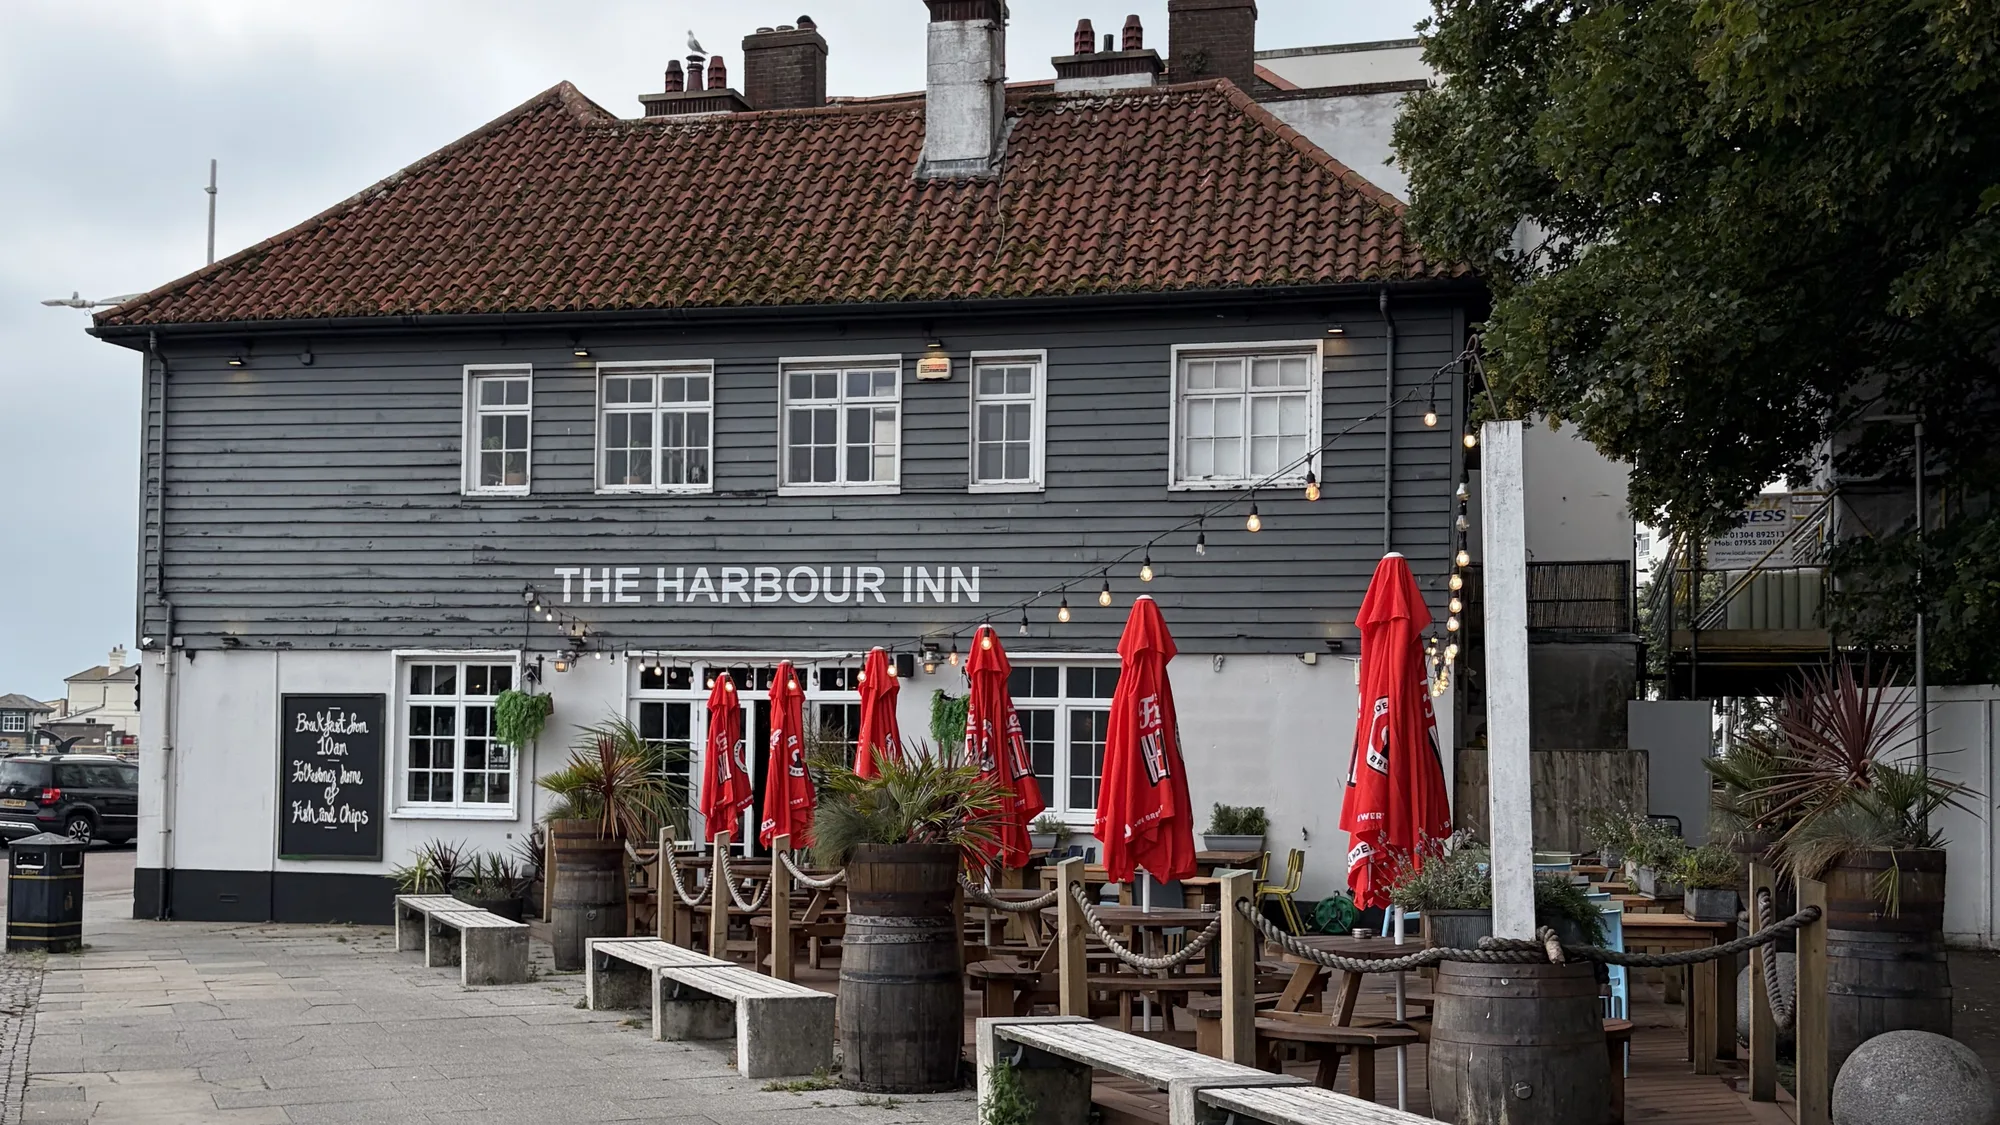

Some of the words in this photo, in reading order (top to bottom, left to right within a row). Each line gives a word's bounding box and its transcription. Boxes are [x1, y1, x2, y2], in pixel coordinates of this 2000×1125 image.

[554, 566, 641, 603] THE
[656, 566, 887, 604] HARBOUR
[902, 565, 981, 603] INN
[295, 710, 347, 738] Breakfast
[346, 712, 370, 735] from
[316, 735, 349, 756] 10am
[340, 763, 364, 785] home
[323, 780, 340, 806] of
[291, 799, 319, 824] Fish
[318, 804, 337, 824] and
[339, 802, 369, 833] Chips
